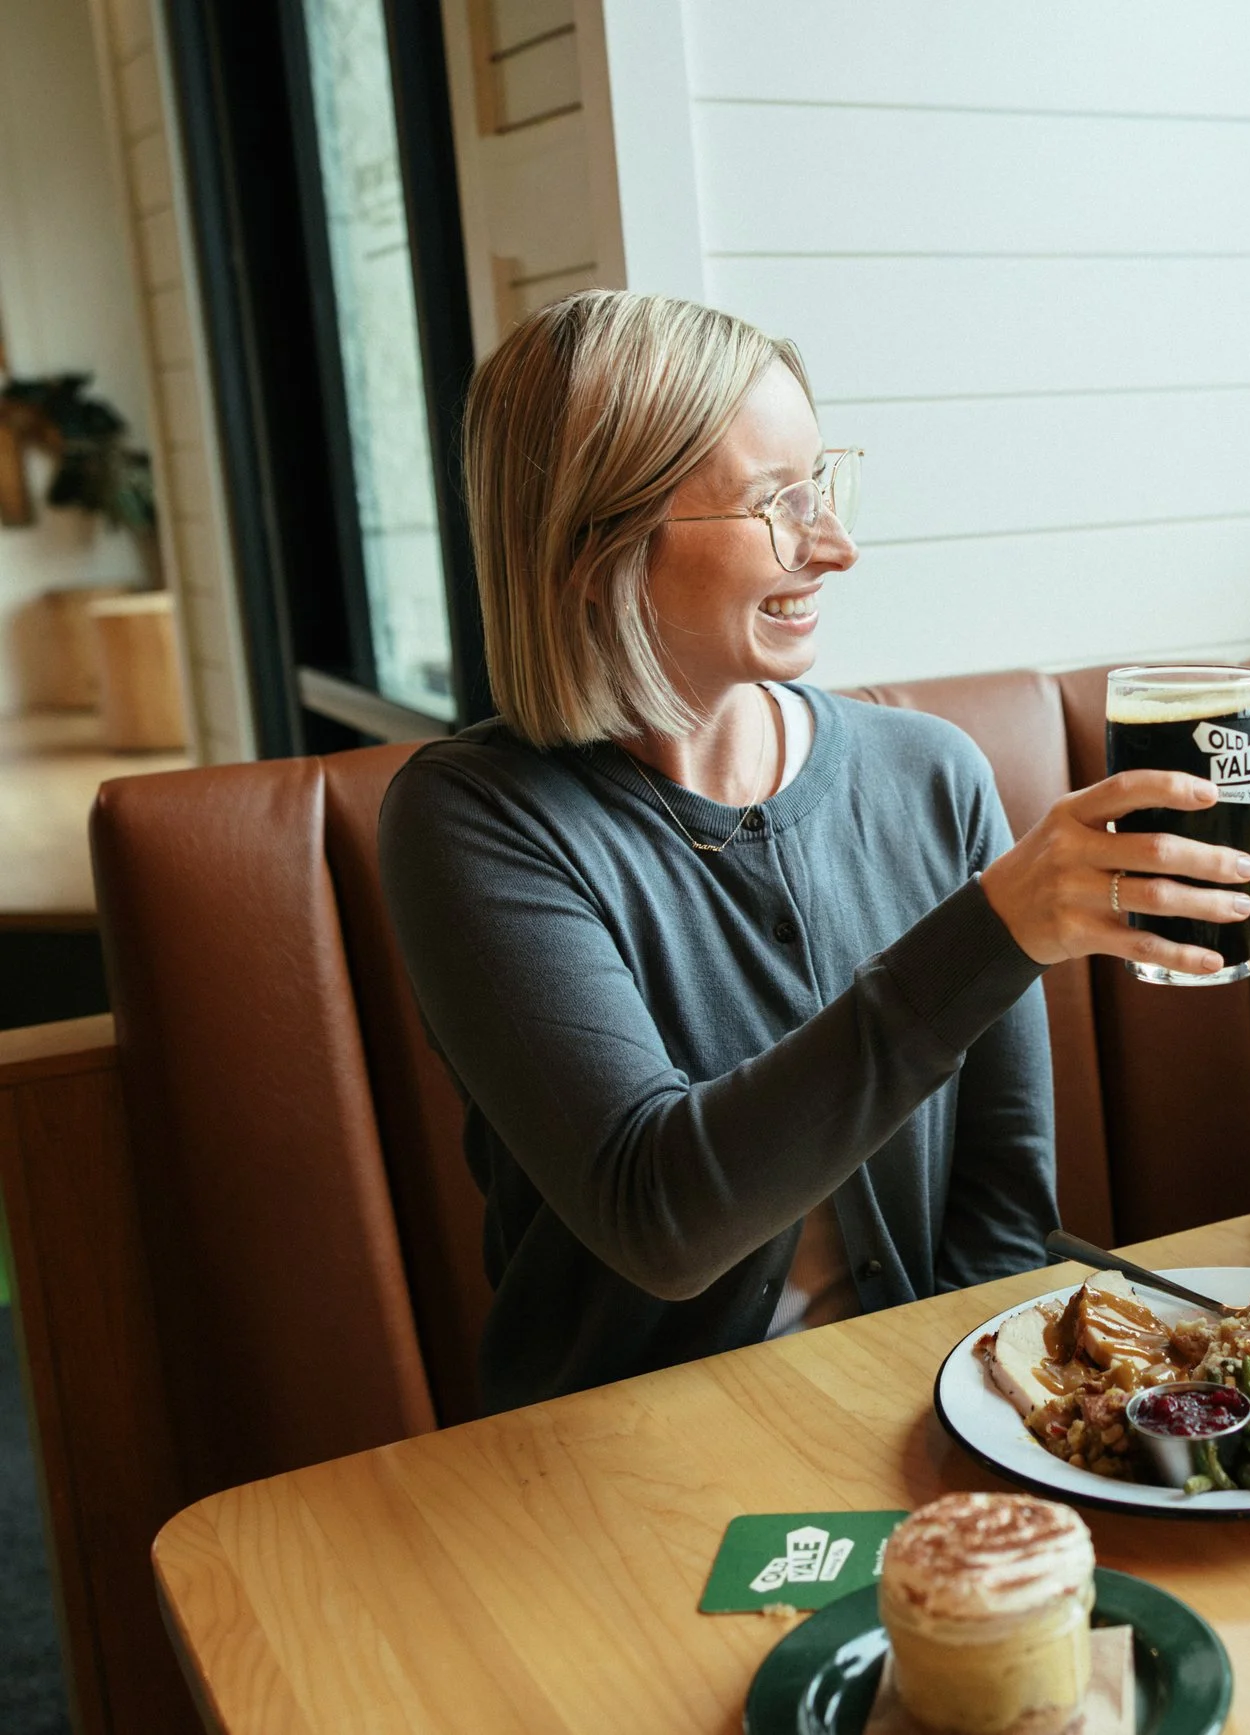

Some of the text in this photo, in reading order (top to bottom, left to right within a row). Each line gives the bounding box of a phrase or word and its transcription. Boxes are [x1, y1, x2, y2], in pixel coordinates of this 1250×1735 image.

[1208, 729, 1245, 751] OLD
[793, 1541, 821, 1577] YALE
[760, 1560, 789, 1583] OLD
